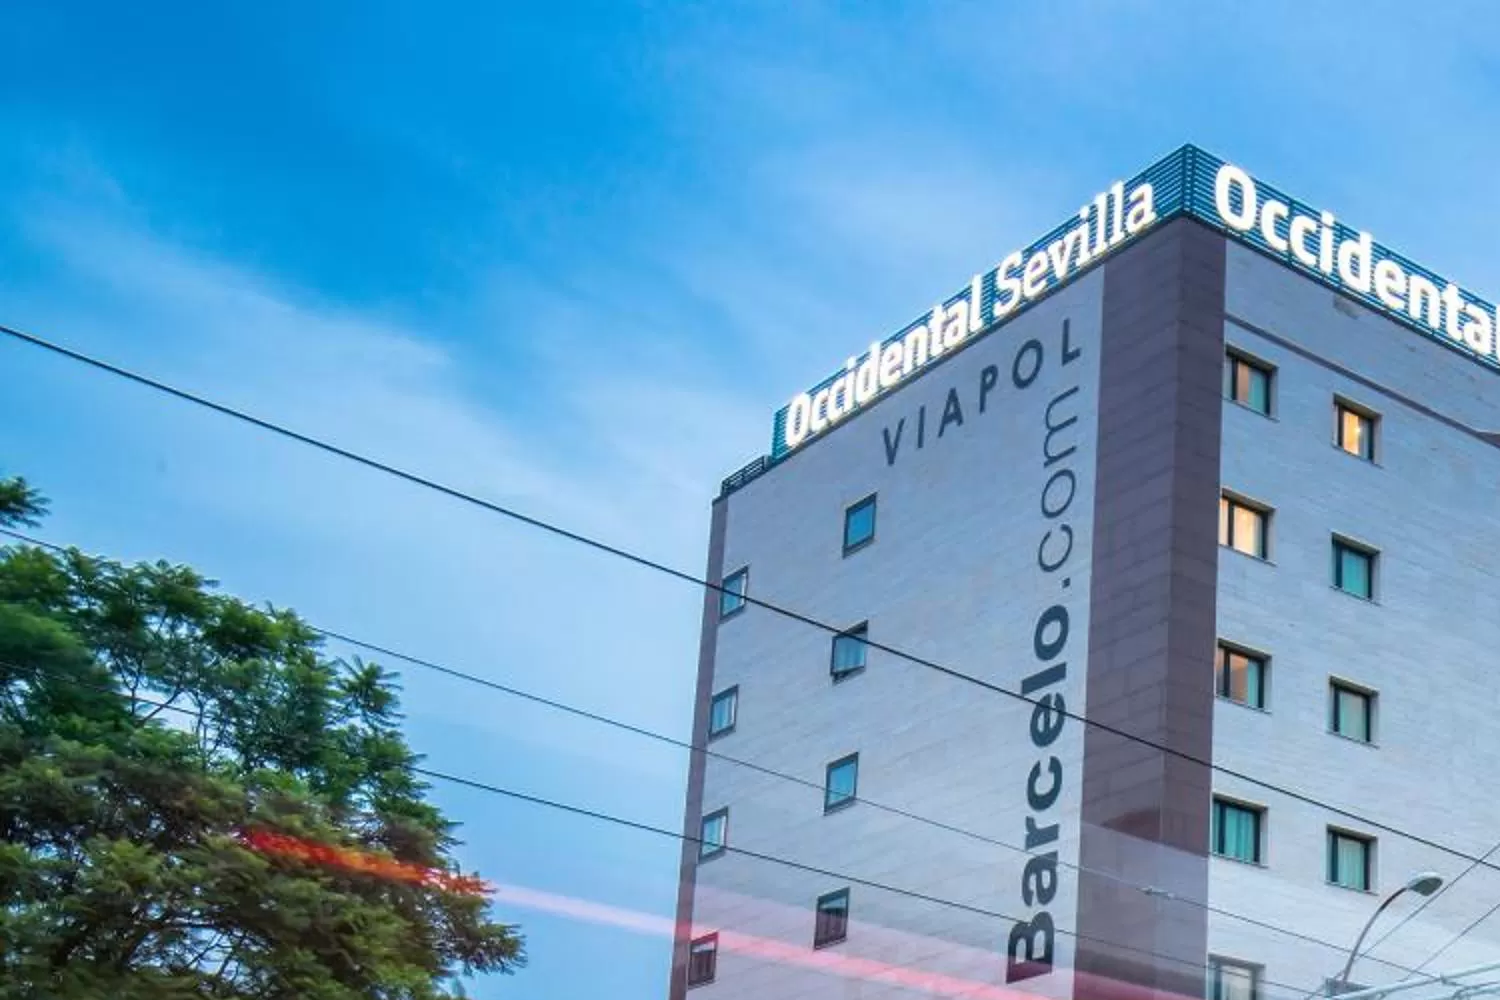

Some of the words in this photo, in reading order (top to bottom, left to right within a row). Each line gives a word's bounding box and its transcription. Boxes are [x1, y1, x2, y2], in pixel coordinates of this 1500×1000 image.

[785, 274, 984, 448] Occidental
[993, 179, 1157, 316] Sevilla
[882, 317, 1081, 467] VIAPOL
[1005, 385, 1081, 985] Barcelo.com
